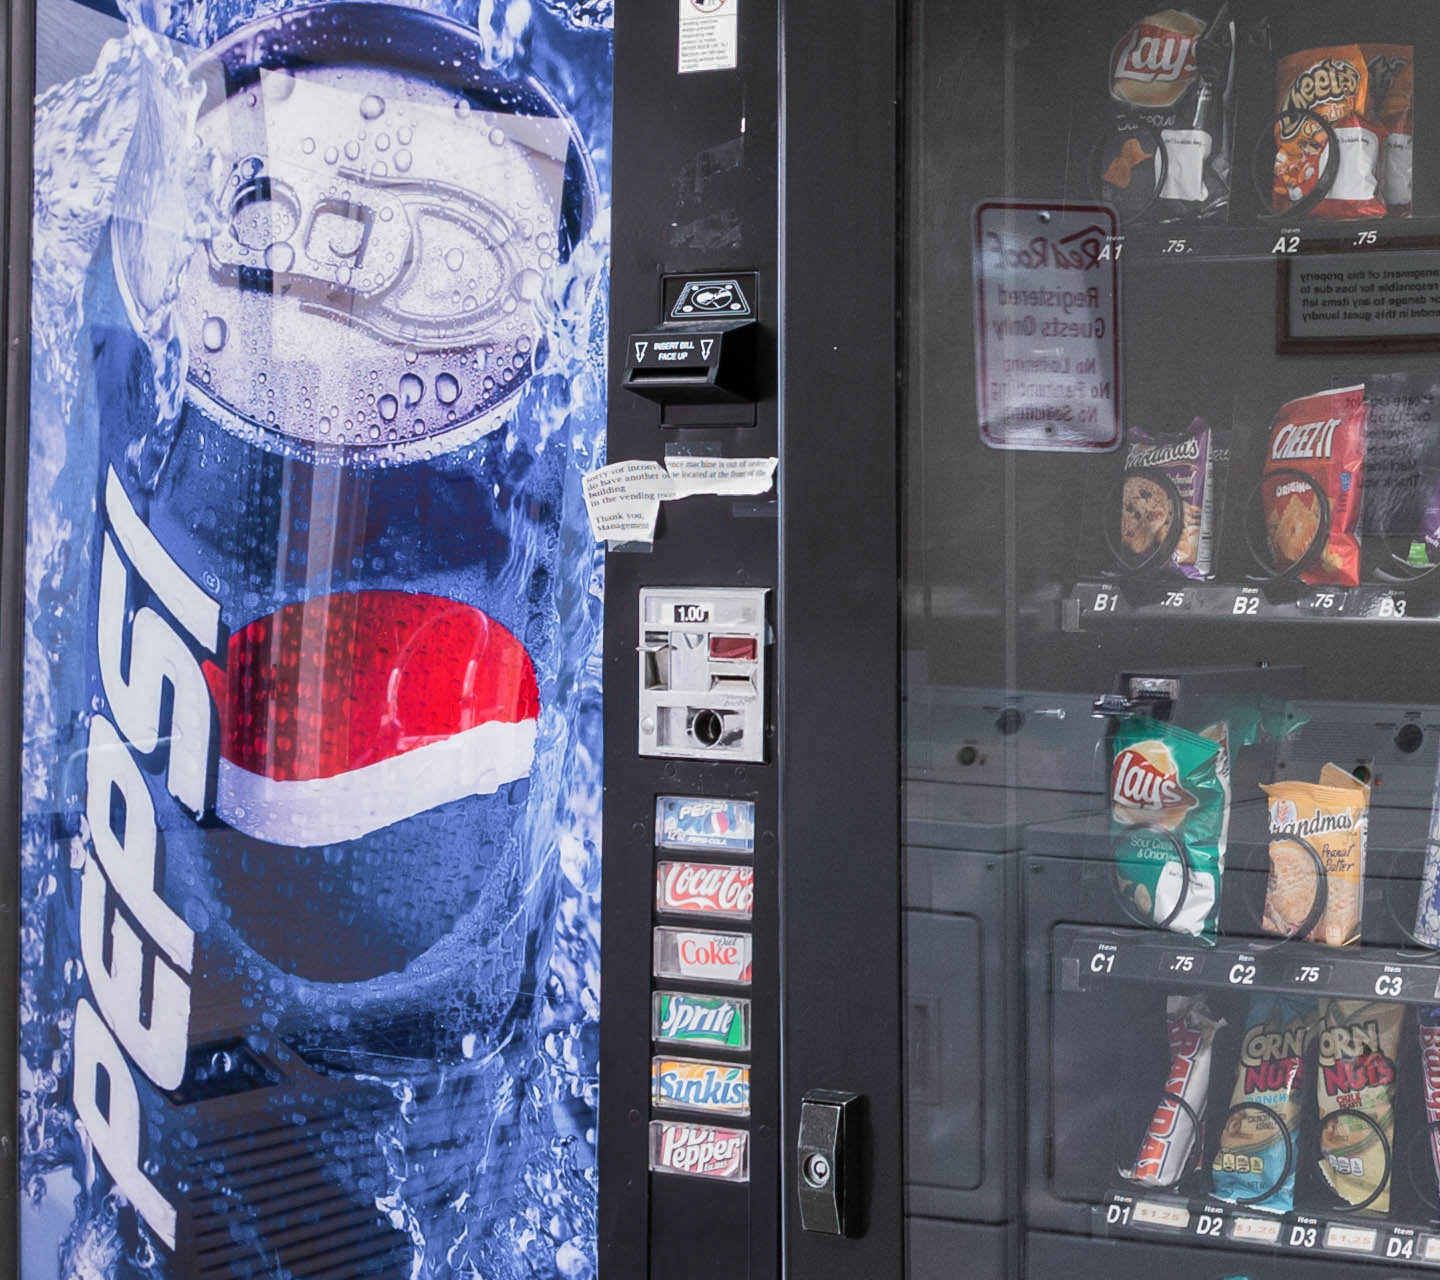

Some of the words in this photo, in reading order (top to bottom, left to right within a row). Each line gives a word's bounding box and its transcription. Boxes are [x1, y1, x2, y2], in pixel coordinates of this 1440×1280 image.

[1272, 237, 1301, 253] A2
[1353, 231, 1377, 245] .75
[1097, 243, 1122, 261] A1
[654, 342, 678, 350] INSERT
[658, 352, 676, 360] FACE
[678, 352, 688, 360] UP
[601, 477, 622, 488] have
[624, 472, 659, 482] another
[588, 485, 626, 498] building
[619, 492, 654, 502] vending
[1094, 593, 1119, 612] B1
[678, 606, 704, 621] 1.00
[1113, 755, 1182, 813] Lay's
[72, 464, 221, 1250] PEPSI
[681, 940, 737, 965] Coke
[1090, 954, 1115, 973] C1
[1170, 956, 1193, 972] .75
[1229, 965, 1256, 985] C2
[1375, 976, 1403, 996] C3
[662, 996, 734, 1038] Sprite
[663, 1125, 740, 1173] Pepper
[1290, 1227, 1317, 1247] D3
